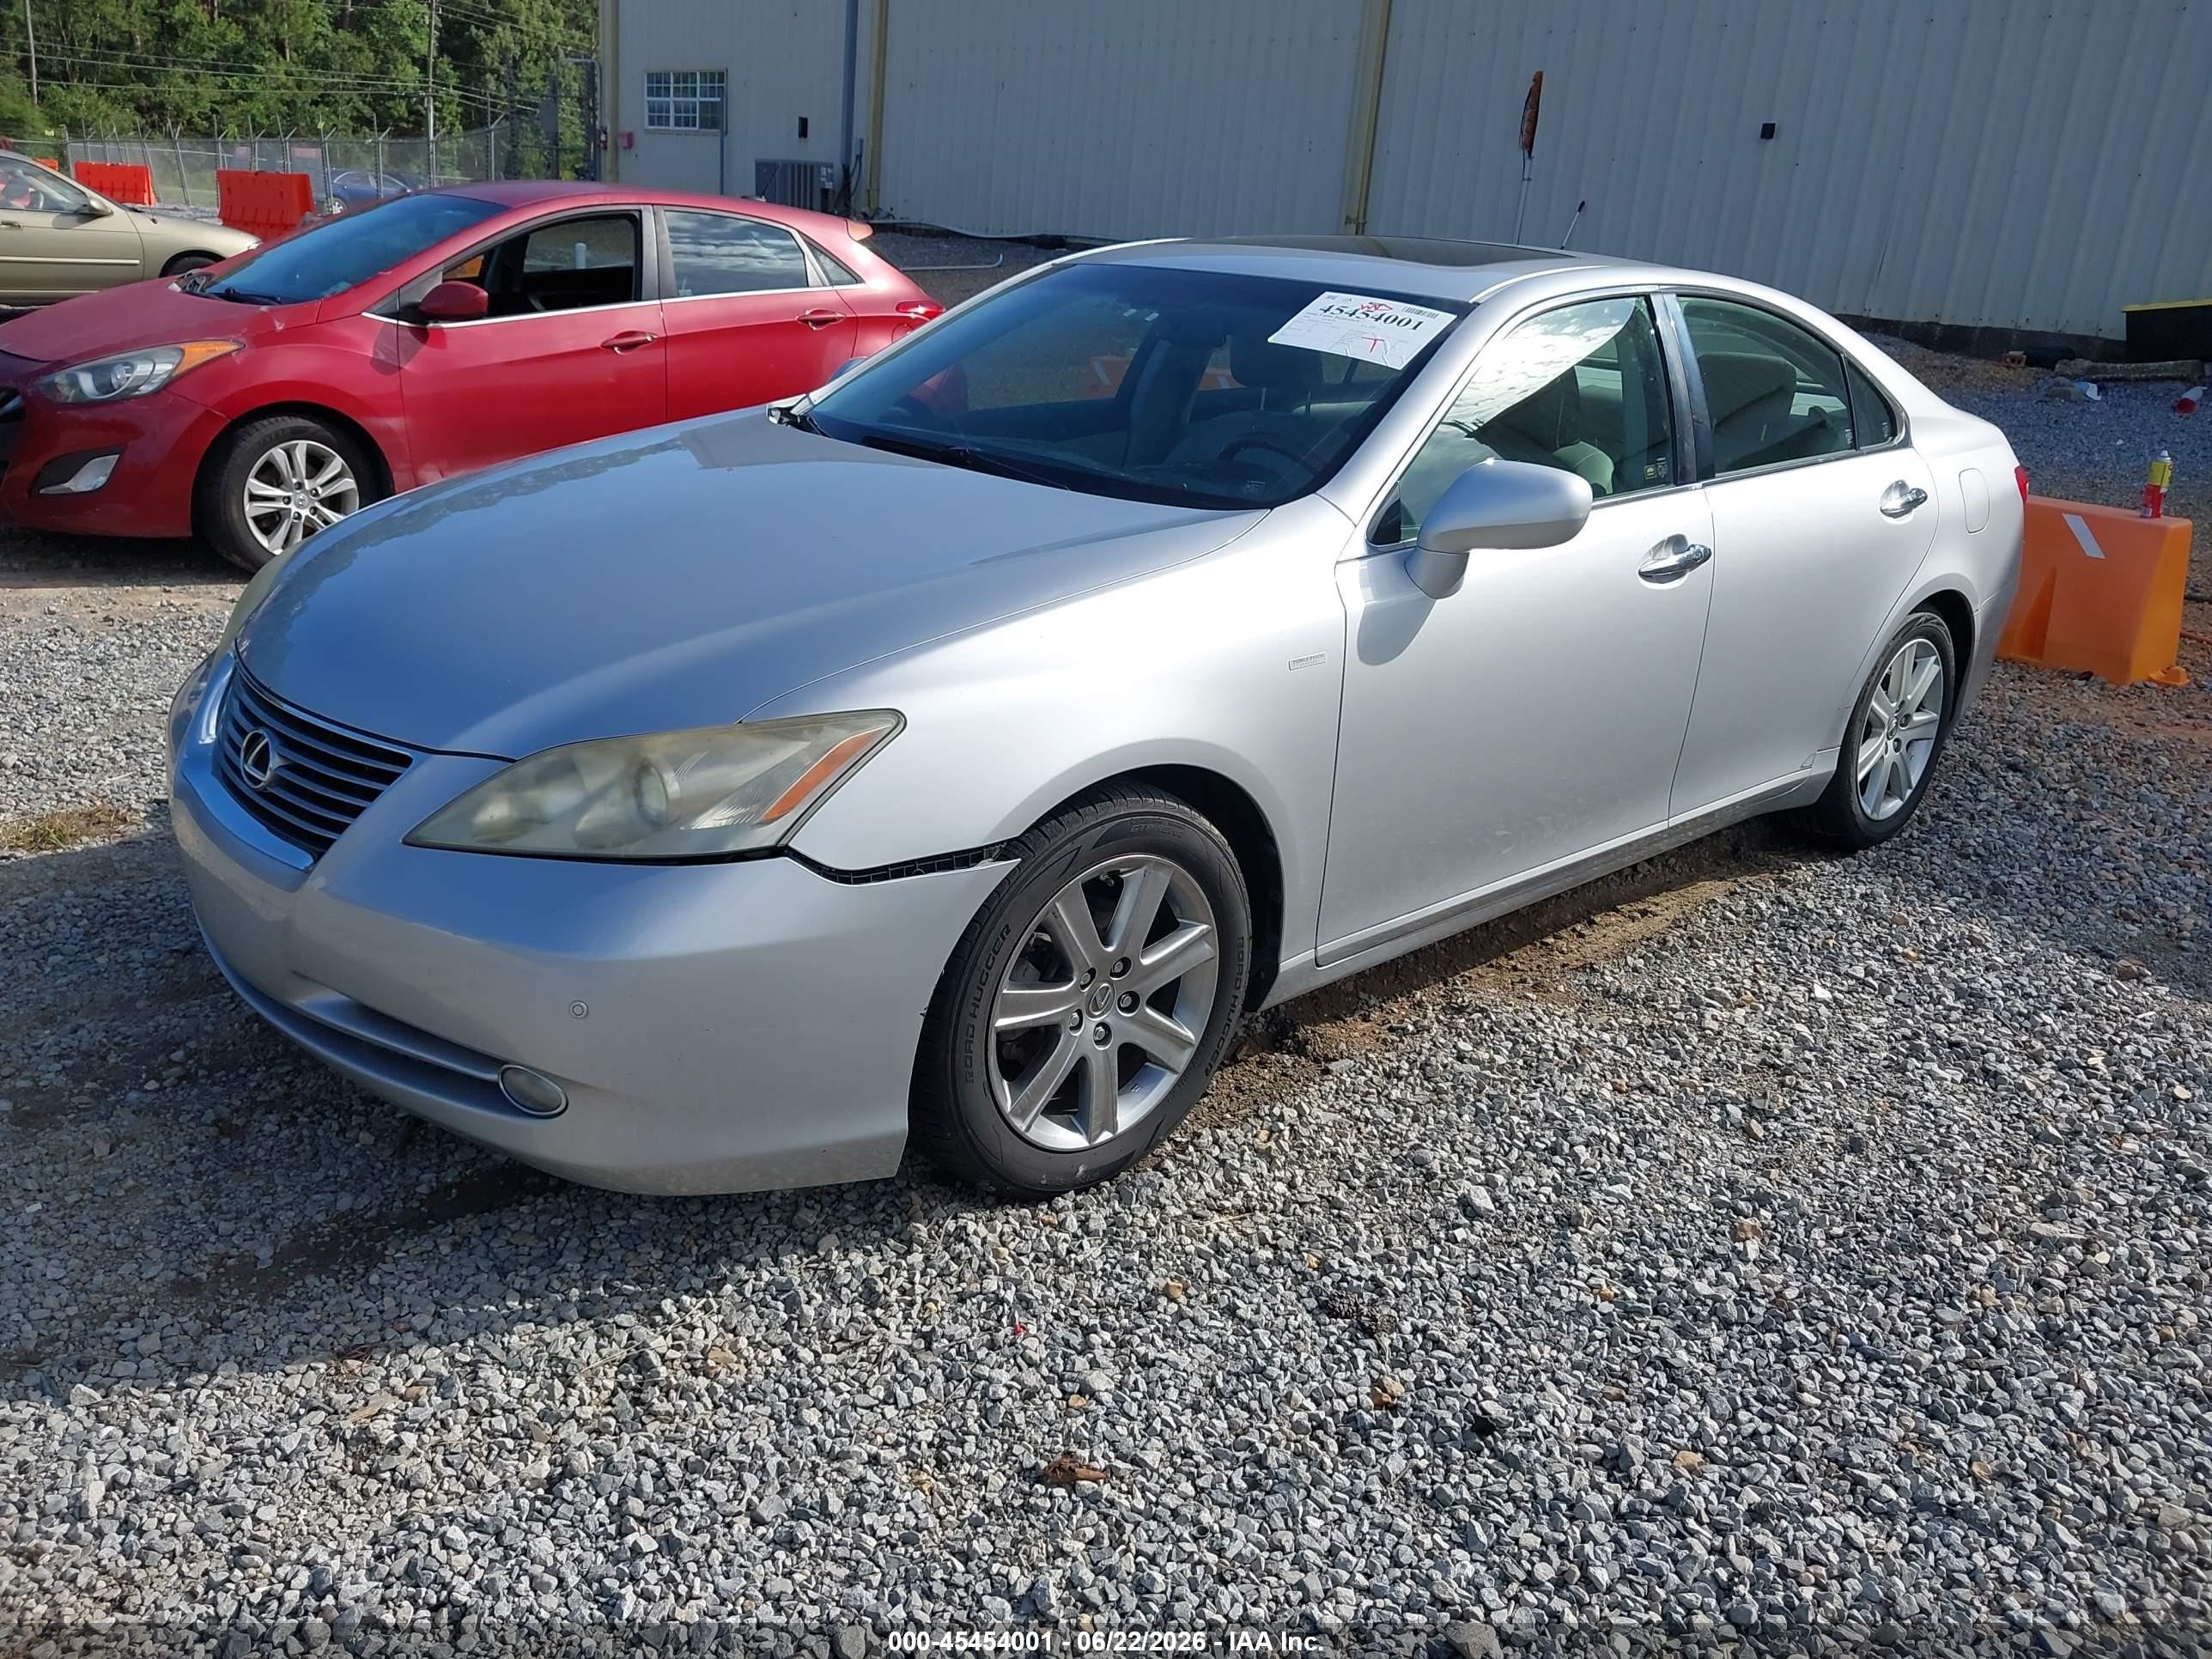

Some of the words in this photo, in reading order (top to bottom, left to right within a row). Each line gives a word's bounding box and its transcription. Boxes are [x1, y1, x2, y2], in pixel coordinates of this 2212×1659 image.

[1319, 304, 1424, 331] 45454001
[969, 923, 1012, 1018] HUGGER
[964, 1024, 975, 1084] ROAD
